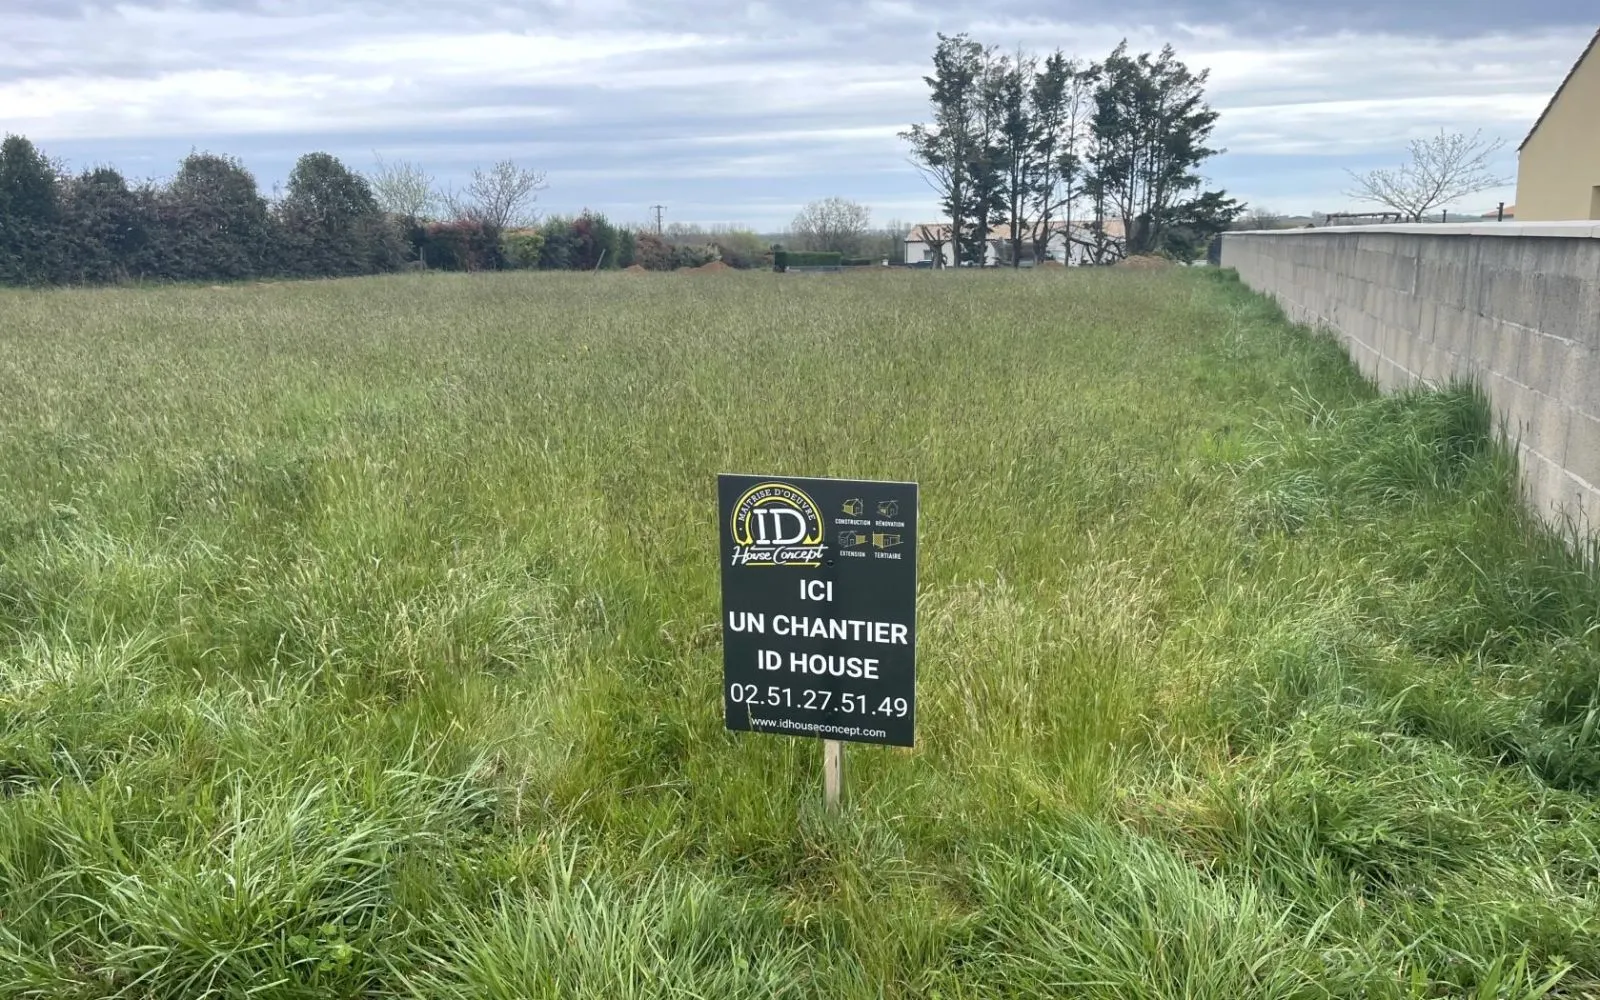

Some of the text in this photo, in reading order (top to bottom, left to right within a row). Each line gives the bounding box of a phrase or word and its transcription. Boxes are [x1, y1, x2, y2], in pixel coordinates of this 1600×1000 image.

[774, 488, 816, 521] D'OEUVRE
[753, 508, 806, 545] ID
[835, 518, 871, 526] CONSTRUCTION
[731, 543, 829, 566] House Concept
[874, 552, 902, 560] TERTIAIRE
[800, 579, 833, 602] ICI
[729, 611, 908, 645] UN CHANTIER
[758, 649, 879, 680] ID HOUSE
[730, 683, 908, 718] 02.51.27.51.49
[751, 717, 886, 738] www.idhouseconcept.com
